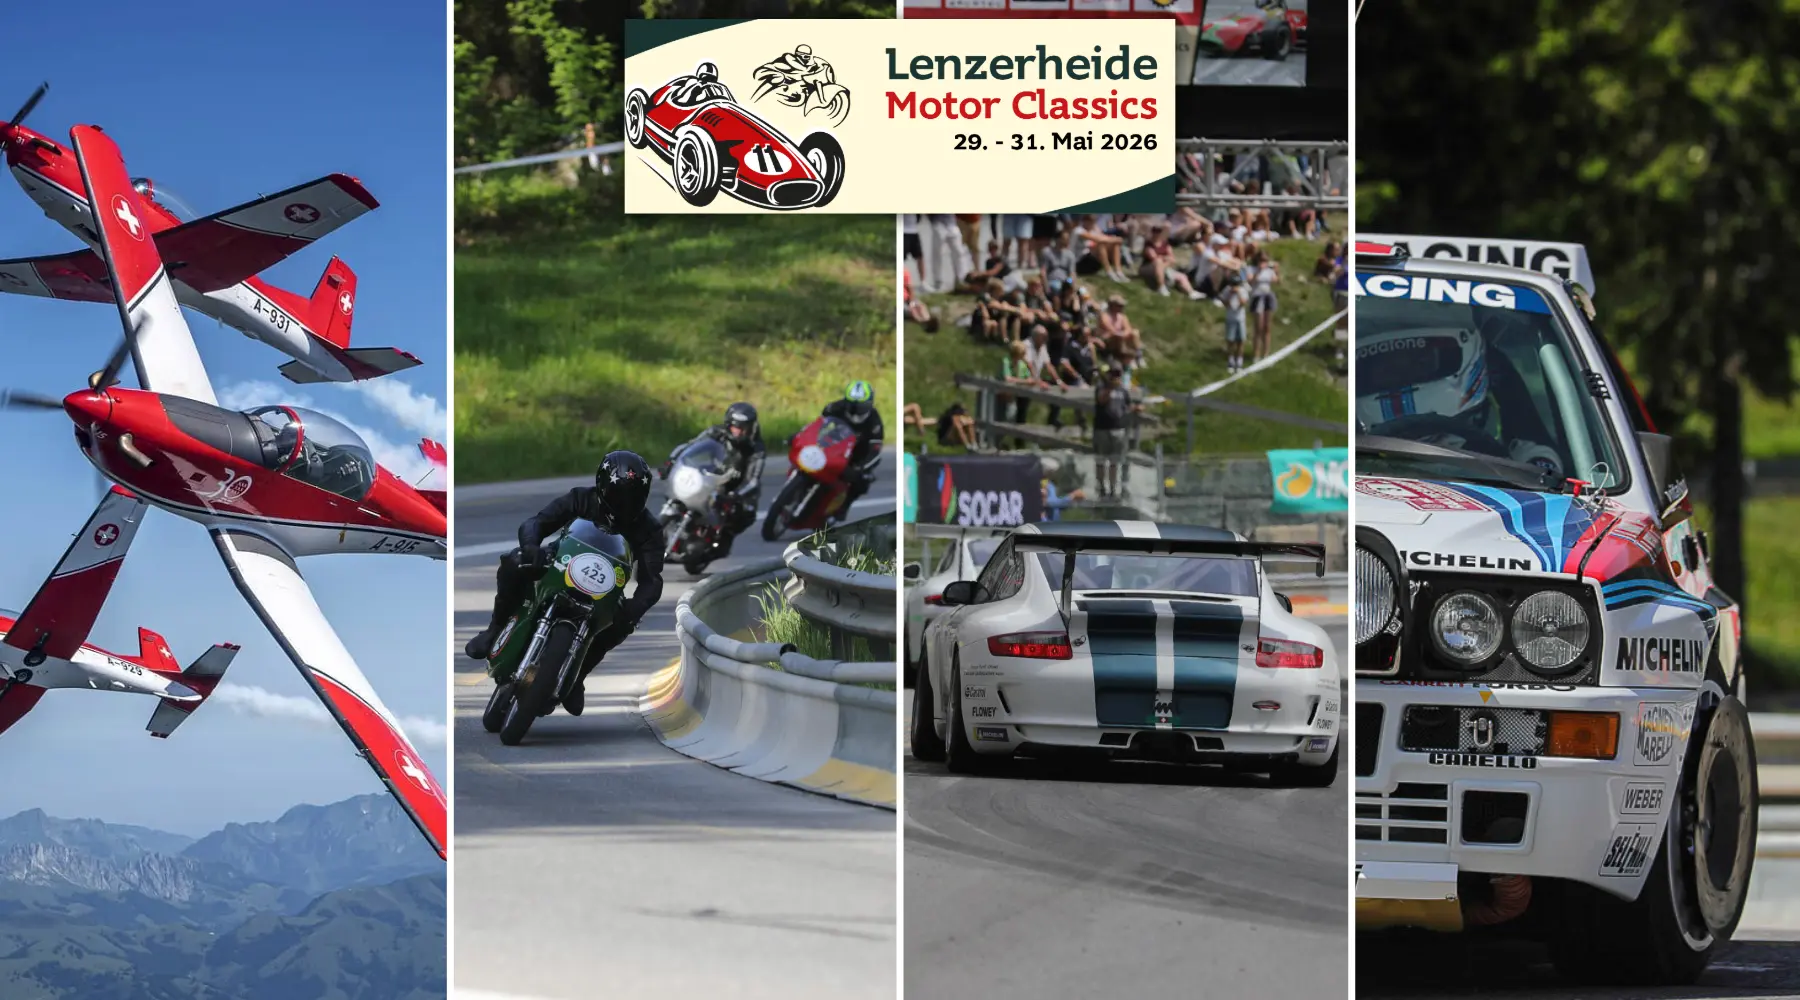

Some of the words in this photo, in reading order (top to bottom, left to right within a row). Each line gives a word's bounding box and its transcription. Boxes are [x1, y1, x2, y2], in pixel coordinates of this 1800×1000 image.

[253, 298, 290, 334] A-931
[958, 490, 1025, 526] SOCAR
[369, 536, 420, 553] A-915
[581, 566, 606, 584] 423
[1616, 637, 1703, 672] MICHELIN
[107, 657, 143, 676] A-929
[972, 706, 996, 717] FLOWEY
[1428, 752, 1538, 770] CARELLO
[1623, 788, 1663, 810] WEBER
